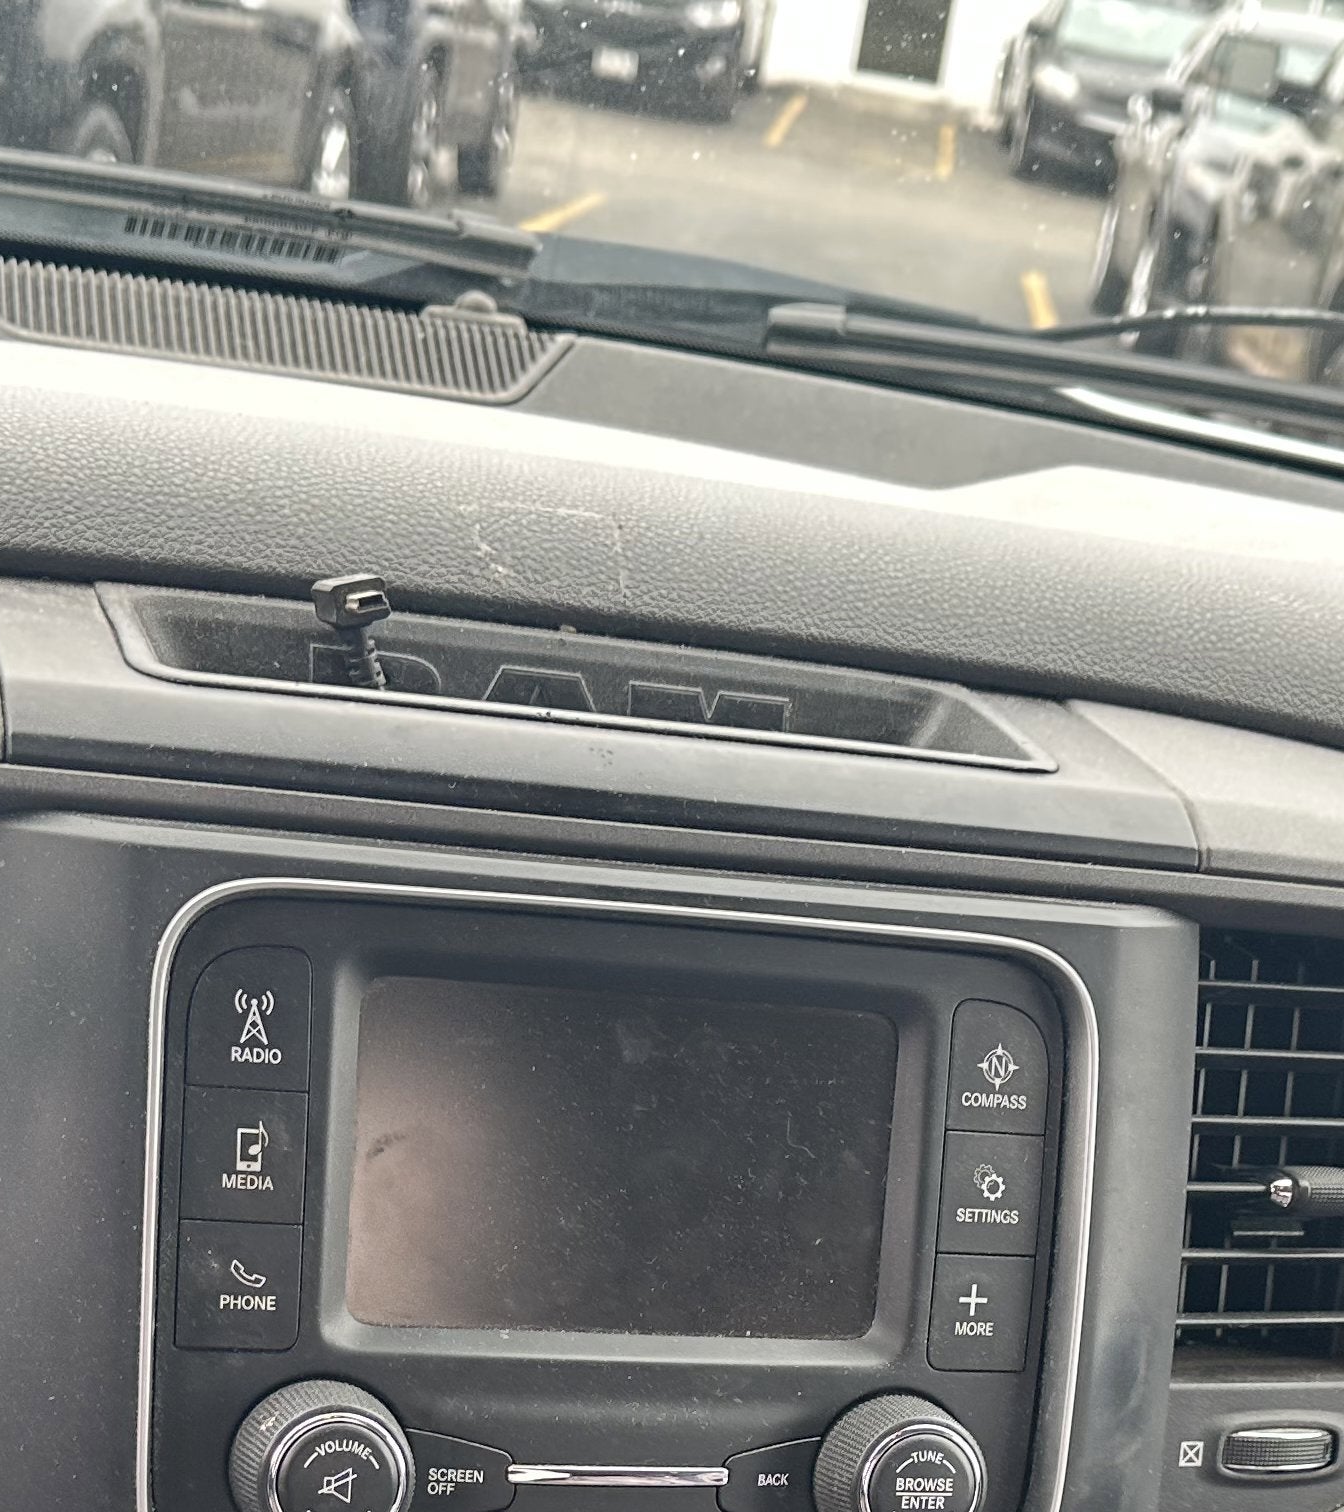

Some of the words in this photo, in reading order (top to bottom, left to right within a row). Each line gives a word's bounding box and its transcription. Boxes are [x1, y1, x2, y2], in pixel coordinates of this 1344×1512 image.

[231, 1046, 282, 1065] RADIO
[962, 1091, 1027, 1110] COMPASS
[221, 1174, 274, 1191] MEDIA
[956, 1207, 1019, 1225] SETTINGS
[219, 1295, 277, 1312] PHONE
[954, 1321, 994, 1337] MORE
[315, 1439, 373, 1460] VOLUME
[911, 1450, 945, 1466] TUNE
[428, 1467, 484, 1484] SCREEN
[757, 1473, 790, 1487] BACK
[427, 1482, 455, 1496] OFF
[896, 1477, 954, 1492] BROWSE
[901, 1496, 945, 1510] ENTER
